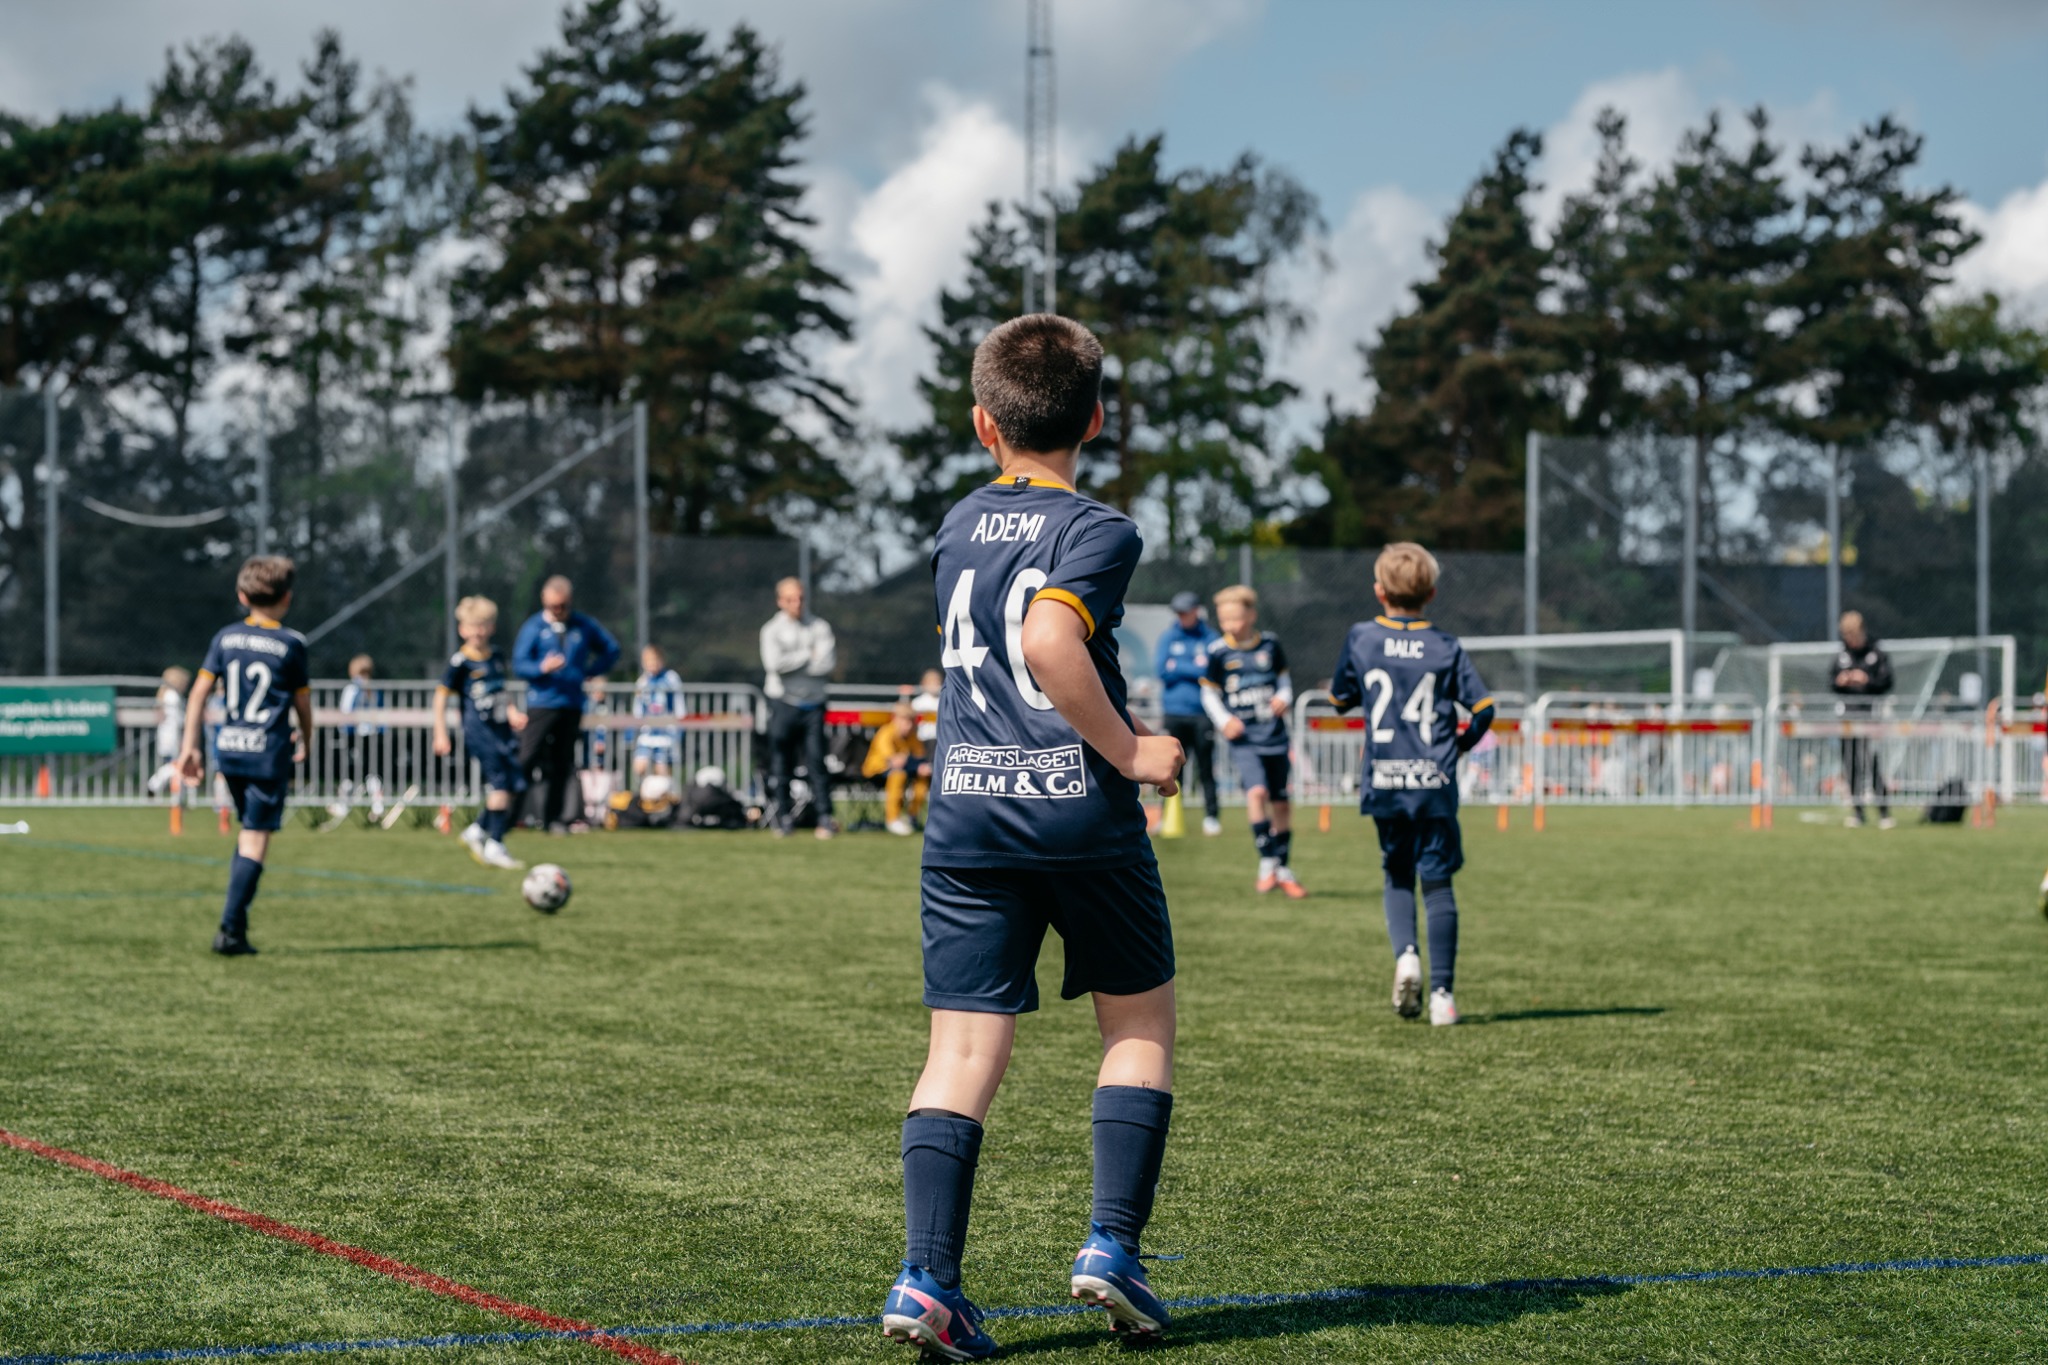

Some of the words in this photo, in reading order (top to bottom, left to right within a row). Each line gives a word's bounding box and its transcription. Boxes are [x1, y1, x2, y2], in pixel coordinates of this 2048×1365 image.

[970, 513, 1047, 544] ADEMI
[1384, 637, 1425, 659] BALIC
[226, 658, 273, 724] 12
[1363, 668, 1439, 746] 24
[949, 748, 1079, 768] ARBETSLAGET
[944, 767, 1006, 794] HJELM
[1013, 771, 1041, 795] &
[1046, 772, 1083, 795] Co
